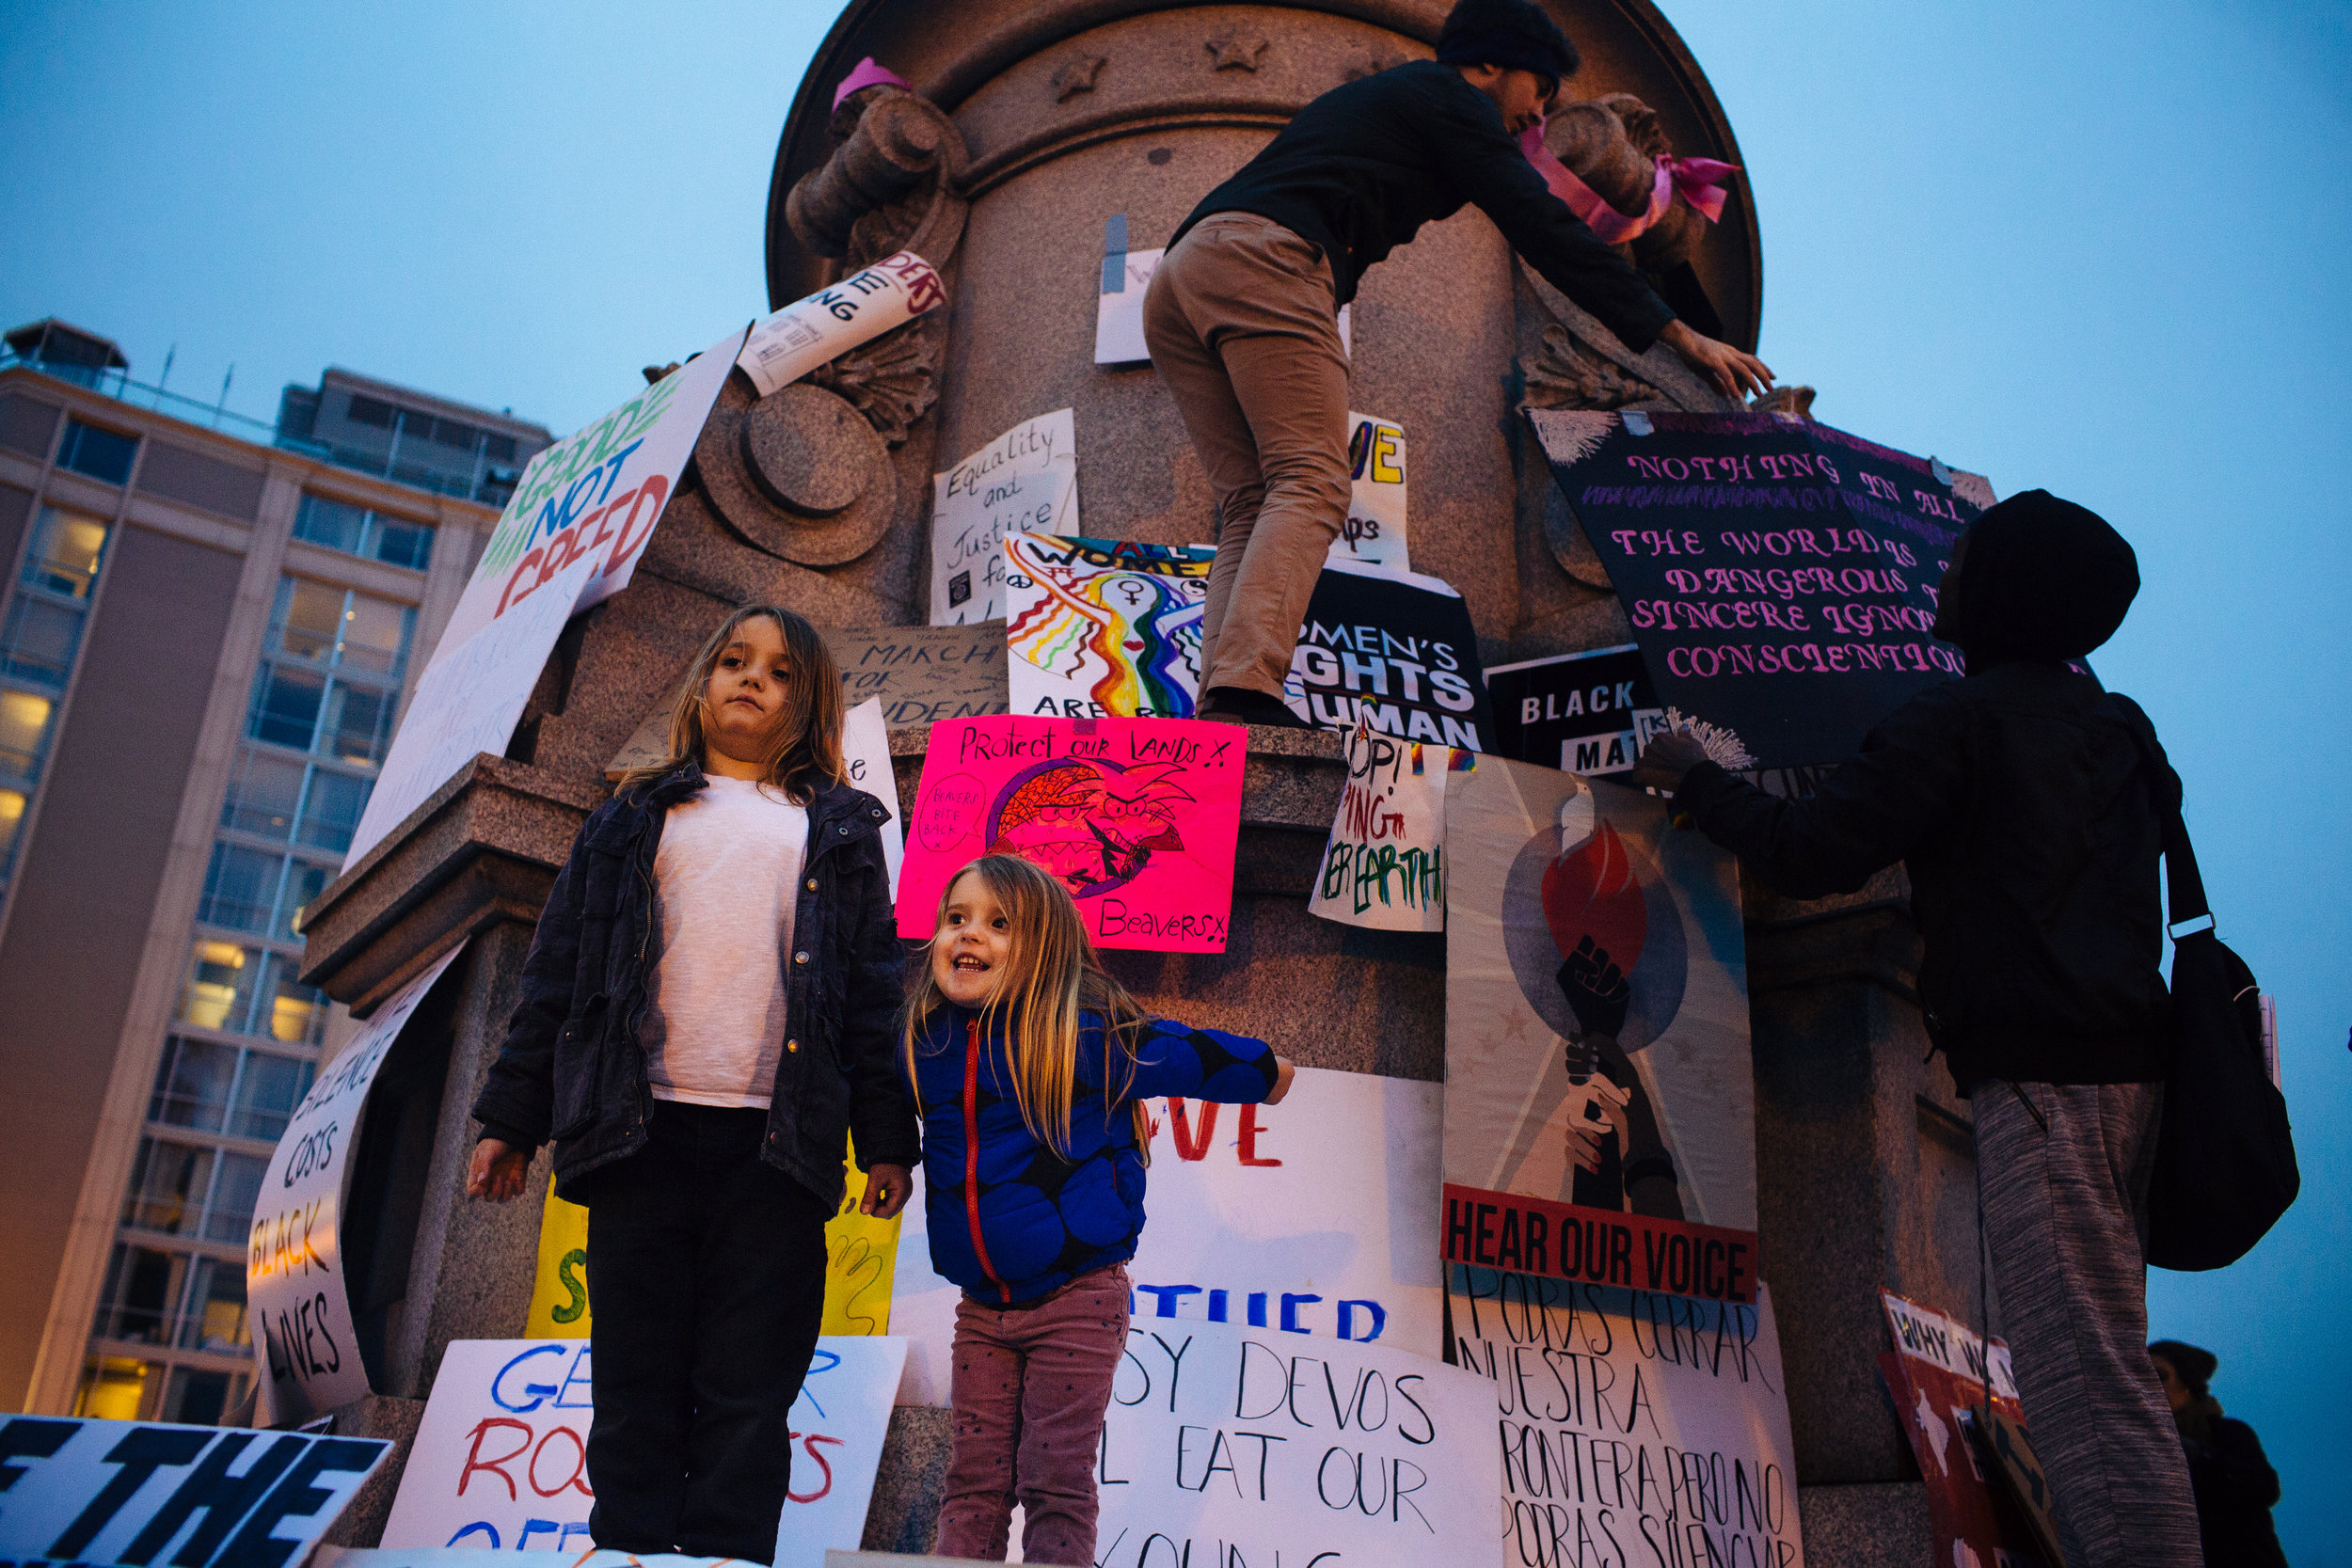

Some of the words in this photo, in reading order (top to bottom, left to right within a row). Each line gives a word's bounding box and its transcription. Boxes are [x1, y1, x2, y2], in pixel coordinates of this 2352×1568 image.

[525, 436, 645, 552] NOT
[946, 422, 1054, 499] Equality
[983, 469, 1023, 509] and
[1627, 453, 1842, 485] NOTHING
[1859, 471, 1902, 504] IN
[1914, 489, 1966, 525] ALL
[947, 502, 1053, 570] Justice
[1611, 529, 1706, 557] THE
[1720, 528, 1881, 559] WORLD
[1883, 538, 1918, 568] IS
[1631, 599, 1812, 632] SINCERE
[1664, 566, 1909, 600] DANGEROUS
[1520, 680, 1635, 725] BLACK
[283, 1119, 339, 1190] COSTS
[250, 1198, 329, 1278] BLACK
[1447, 1197, 1549, 1275] HEAR
[1559, 1216, 1633, 1287] OUR
[1644, 1228, 1748, 1303] VOICE
[1891, 1307, 1951, 1367] WHY
[1234, 1341, 1436, 1446] DEVOS
[45, 1426, 390, 1568] THE
[1176, 1424, 1288, 1502] EAT
[1317, 1446, 1437, 1536] OUR
[1664, 1446, 1729, 1527] PERO
[1734, 1457, 1785, 1536] NO
